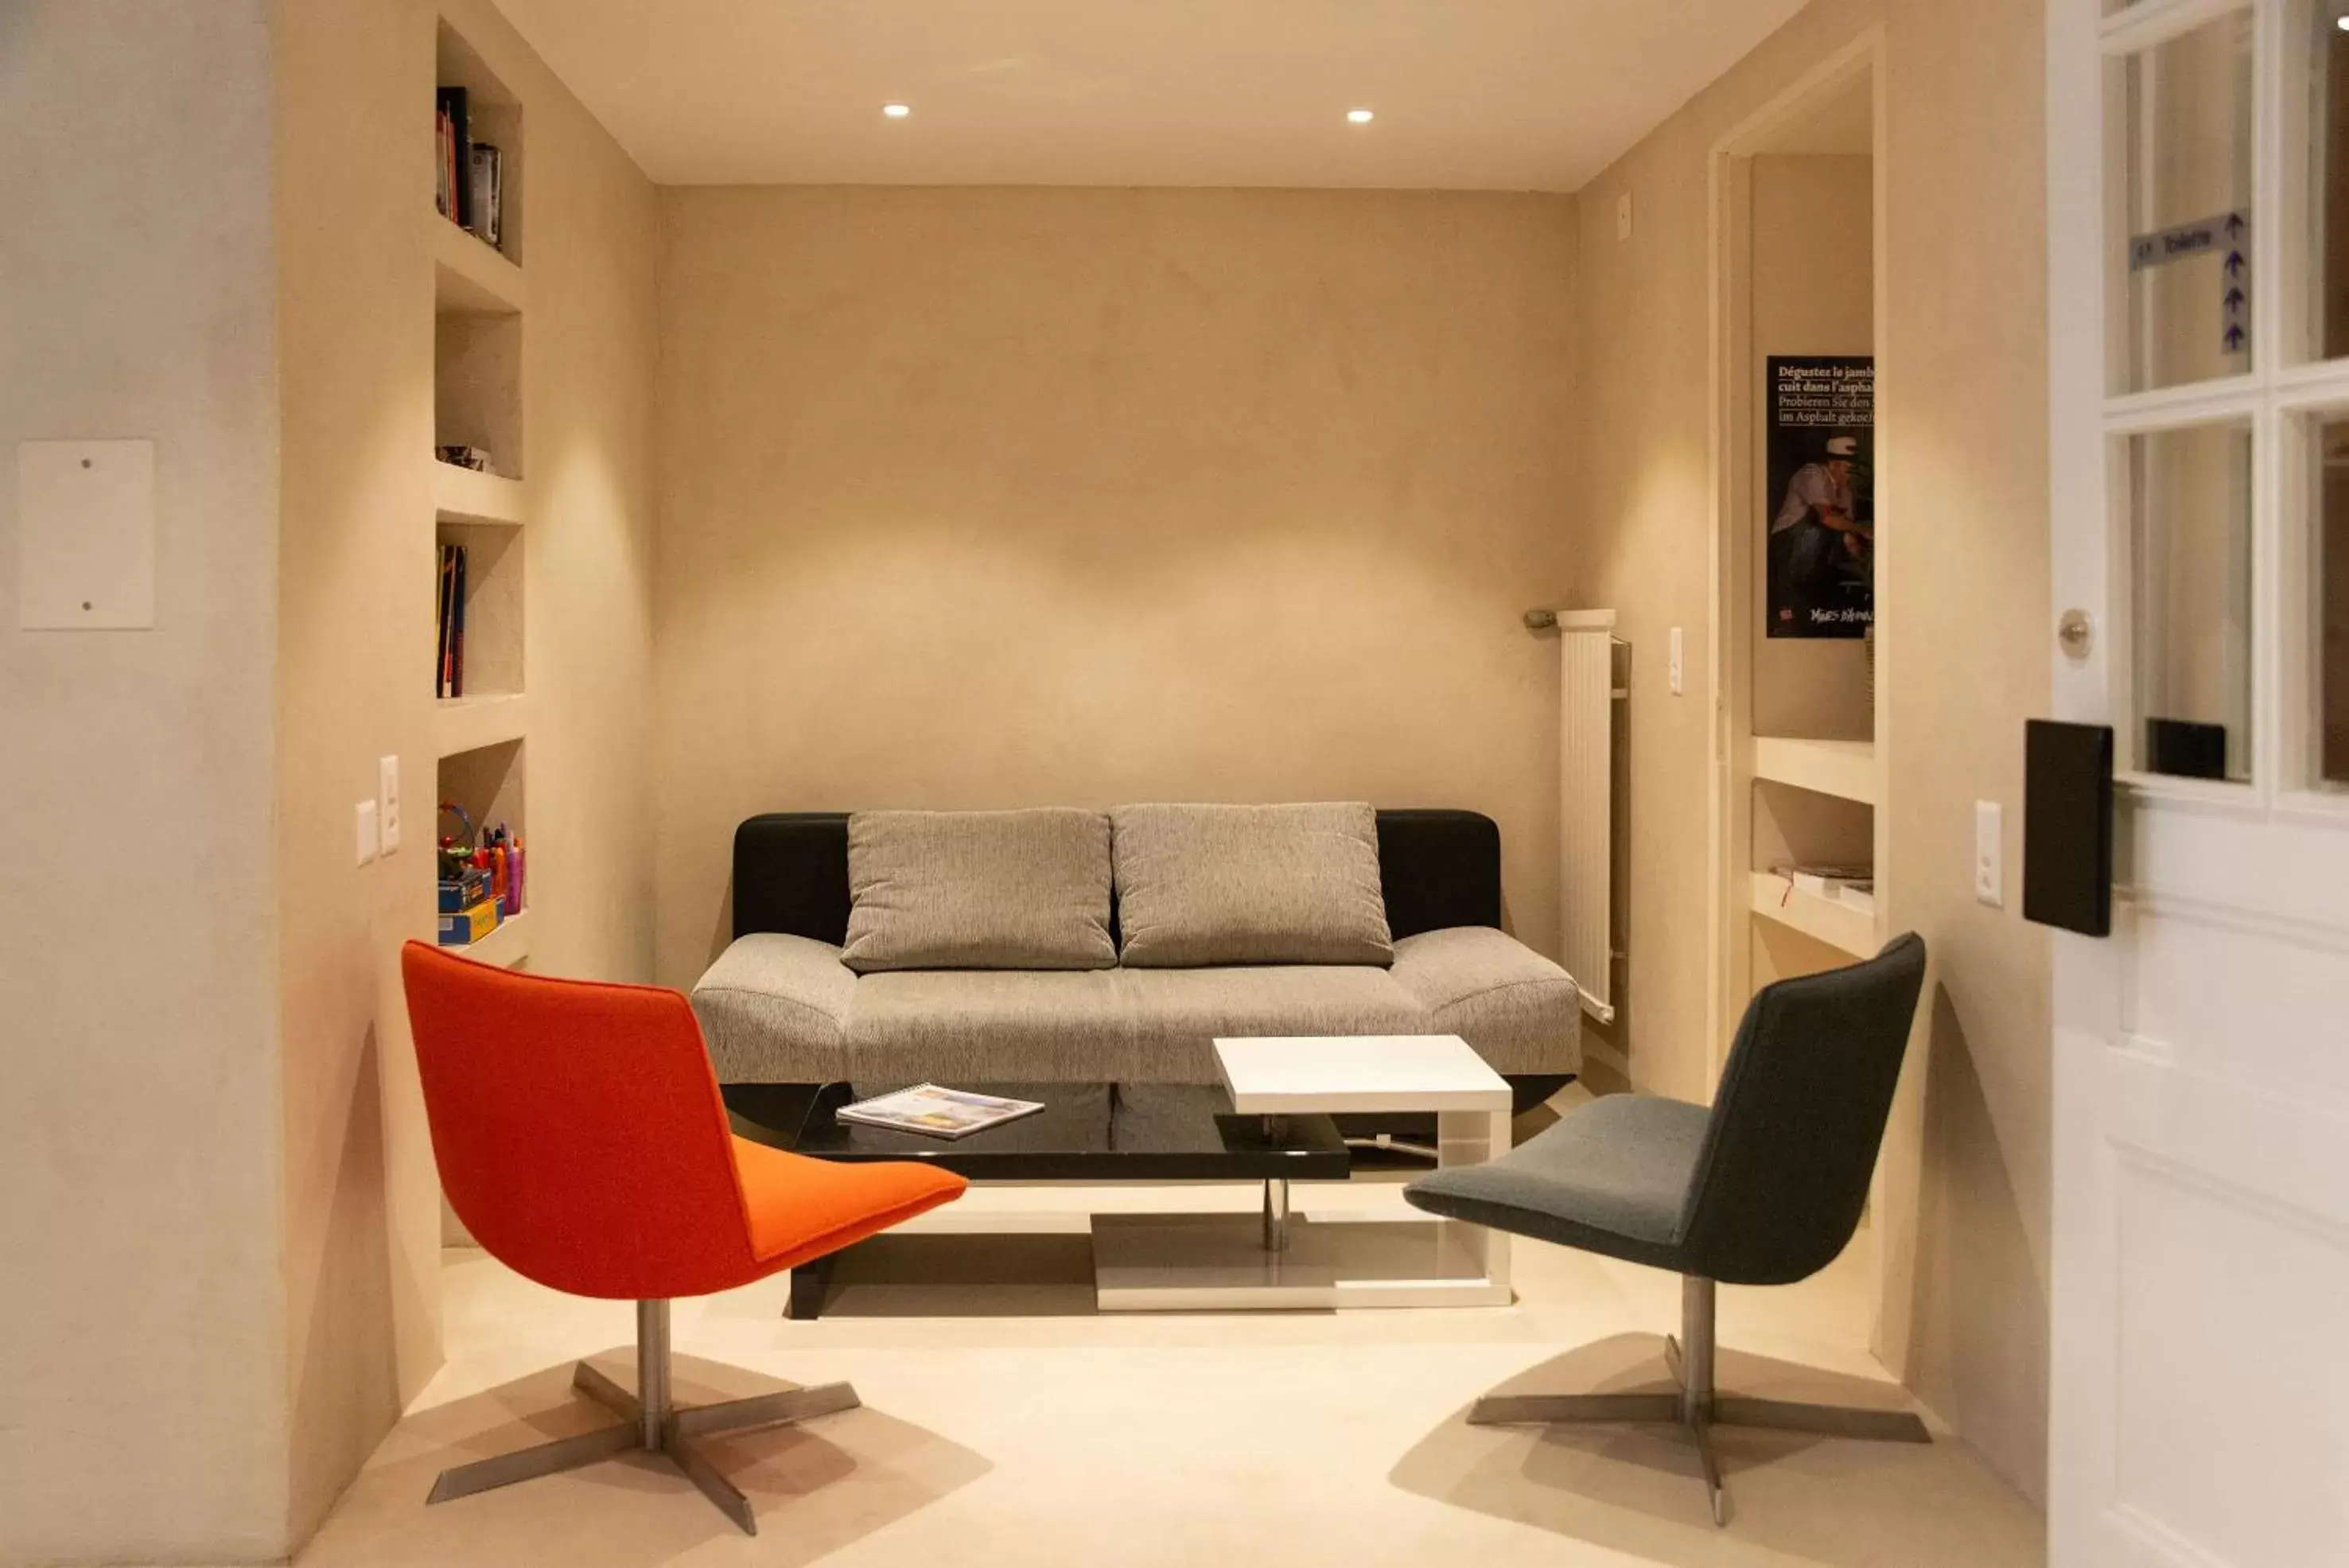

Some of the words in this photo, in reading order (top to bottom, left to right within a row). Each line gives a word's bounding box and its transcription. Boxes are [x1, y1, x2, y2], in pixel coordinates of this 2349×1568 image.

[1779, 365, 1831, 379] Dégustez
[1833, 366, 1844, 376] le
[1779, 381, 1801, 392] cuit
[1803, 380, 1830, 392] dans
[1779, 395, 1830, 407] Probieren
[1832, 395, 1847, 407] Sie
[1849, 395, 1870, 407] den
[1796, 410, 1837, 425] Asphalt
